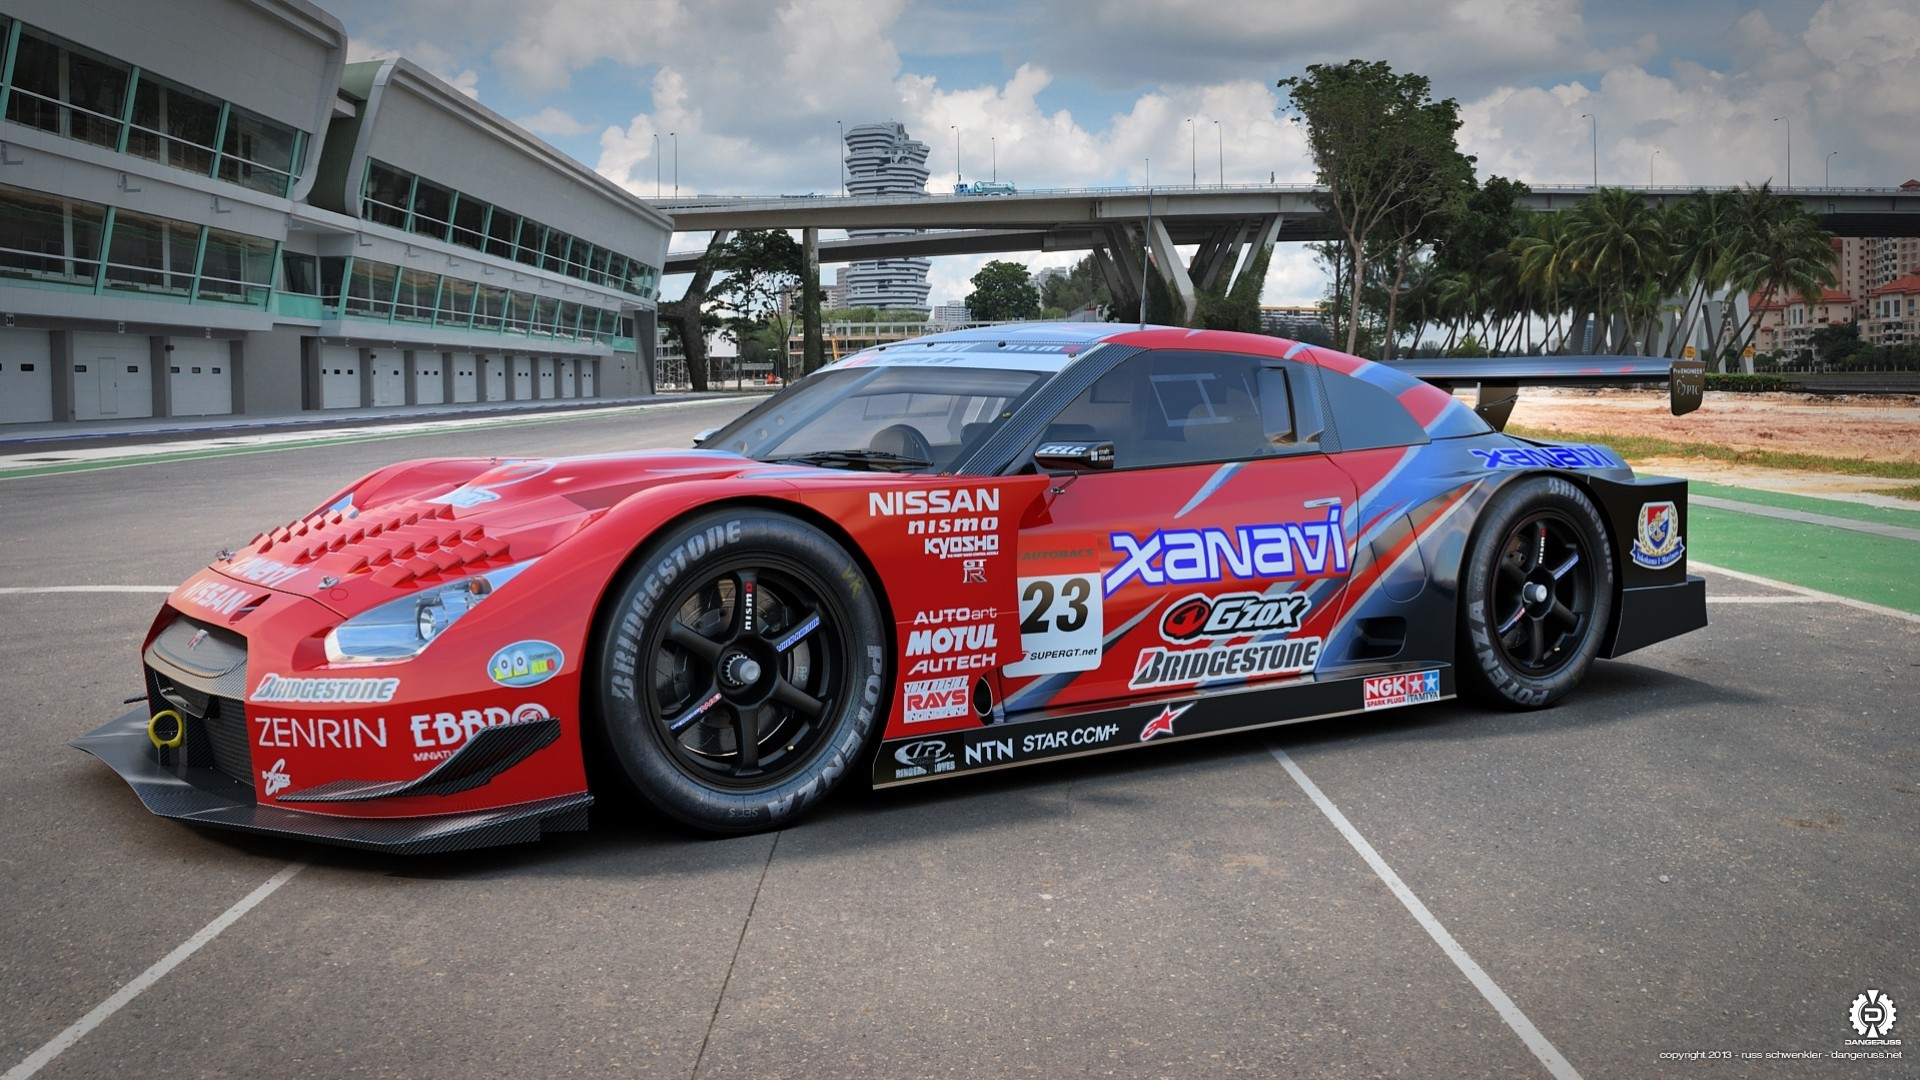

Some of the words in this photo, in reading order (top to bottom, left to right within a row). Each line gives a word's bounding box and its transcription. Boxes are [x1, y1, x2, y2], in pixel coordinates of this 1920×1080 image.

[868, 488, 1000, 517] NISSAN
[907, 516, 999, 535] nismo
[1023, 549, 1094, 561] AUTOBACS
[176, 578, 253, 615] NISSAN
[611, 520, 741, 701] BRIDGESTONE
[744, 582, 753, 631] nismo
[1020, 577, 1091, 635] 23
[905, 623, 998, 657] MOTUL
[1030, 647, 1098, 661] SUPERGT.net
[1468, 599, 1550, 705] POTENZA
[907, 652, 998, 676] AUTECH
[1132, 640, 1319, 686] BRIDGESTONE
[254, 675, 397, 699] BRIDGESTONE
[907, 688, 967, 712] RAYS
[1365, 676, 1406, 699] NGK
[1410, 692, 1438, 703] TAMIYA
[1367, 699, 1385, 708] SPARK
[1387, 697, 1406, 705] PLUGS
[255, 717, 388, 749] ZENRIN
[766, 645, 884, 821] POTENZA
[1022, 734, 1068, 753] STAR
[1071, 723, 1120, 746] CCM+
[964, 738, 1014, 766] NTN
[928, 761, 956, 774] LOVES
